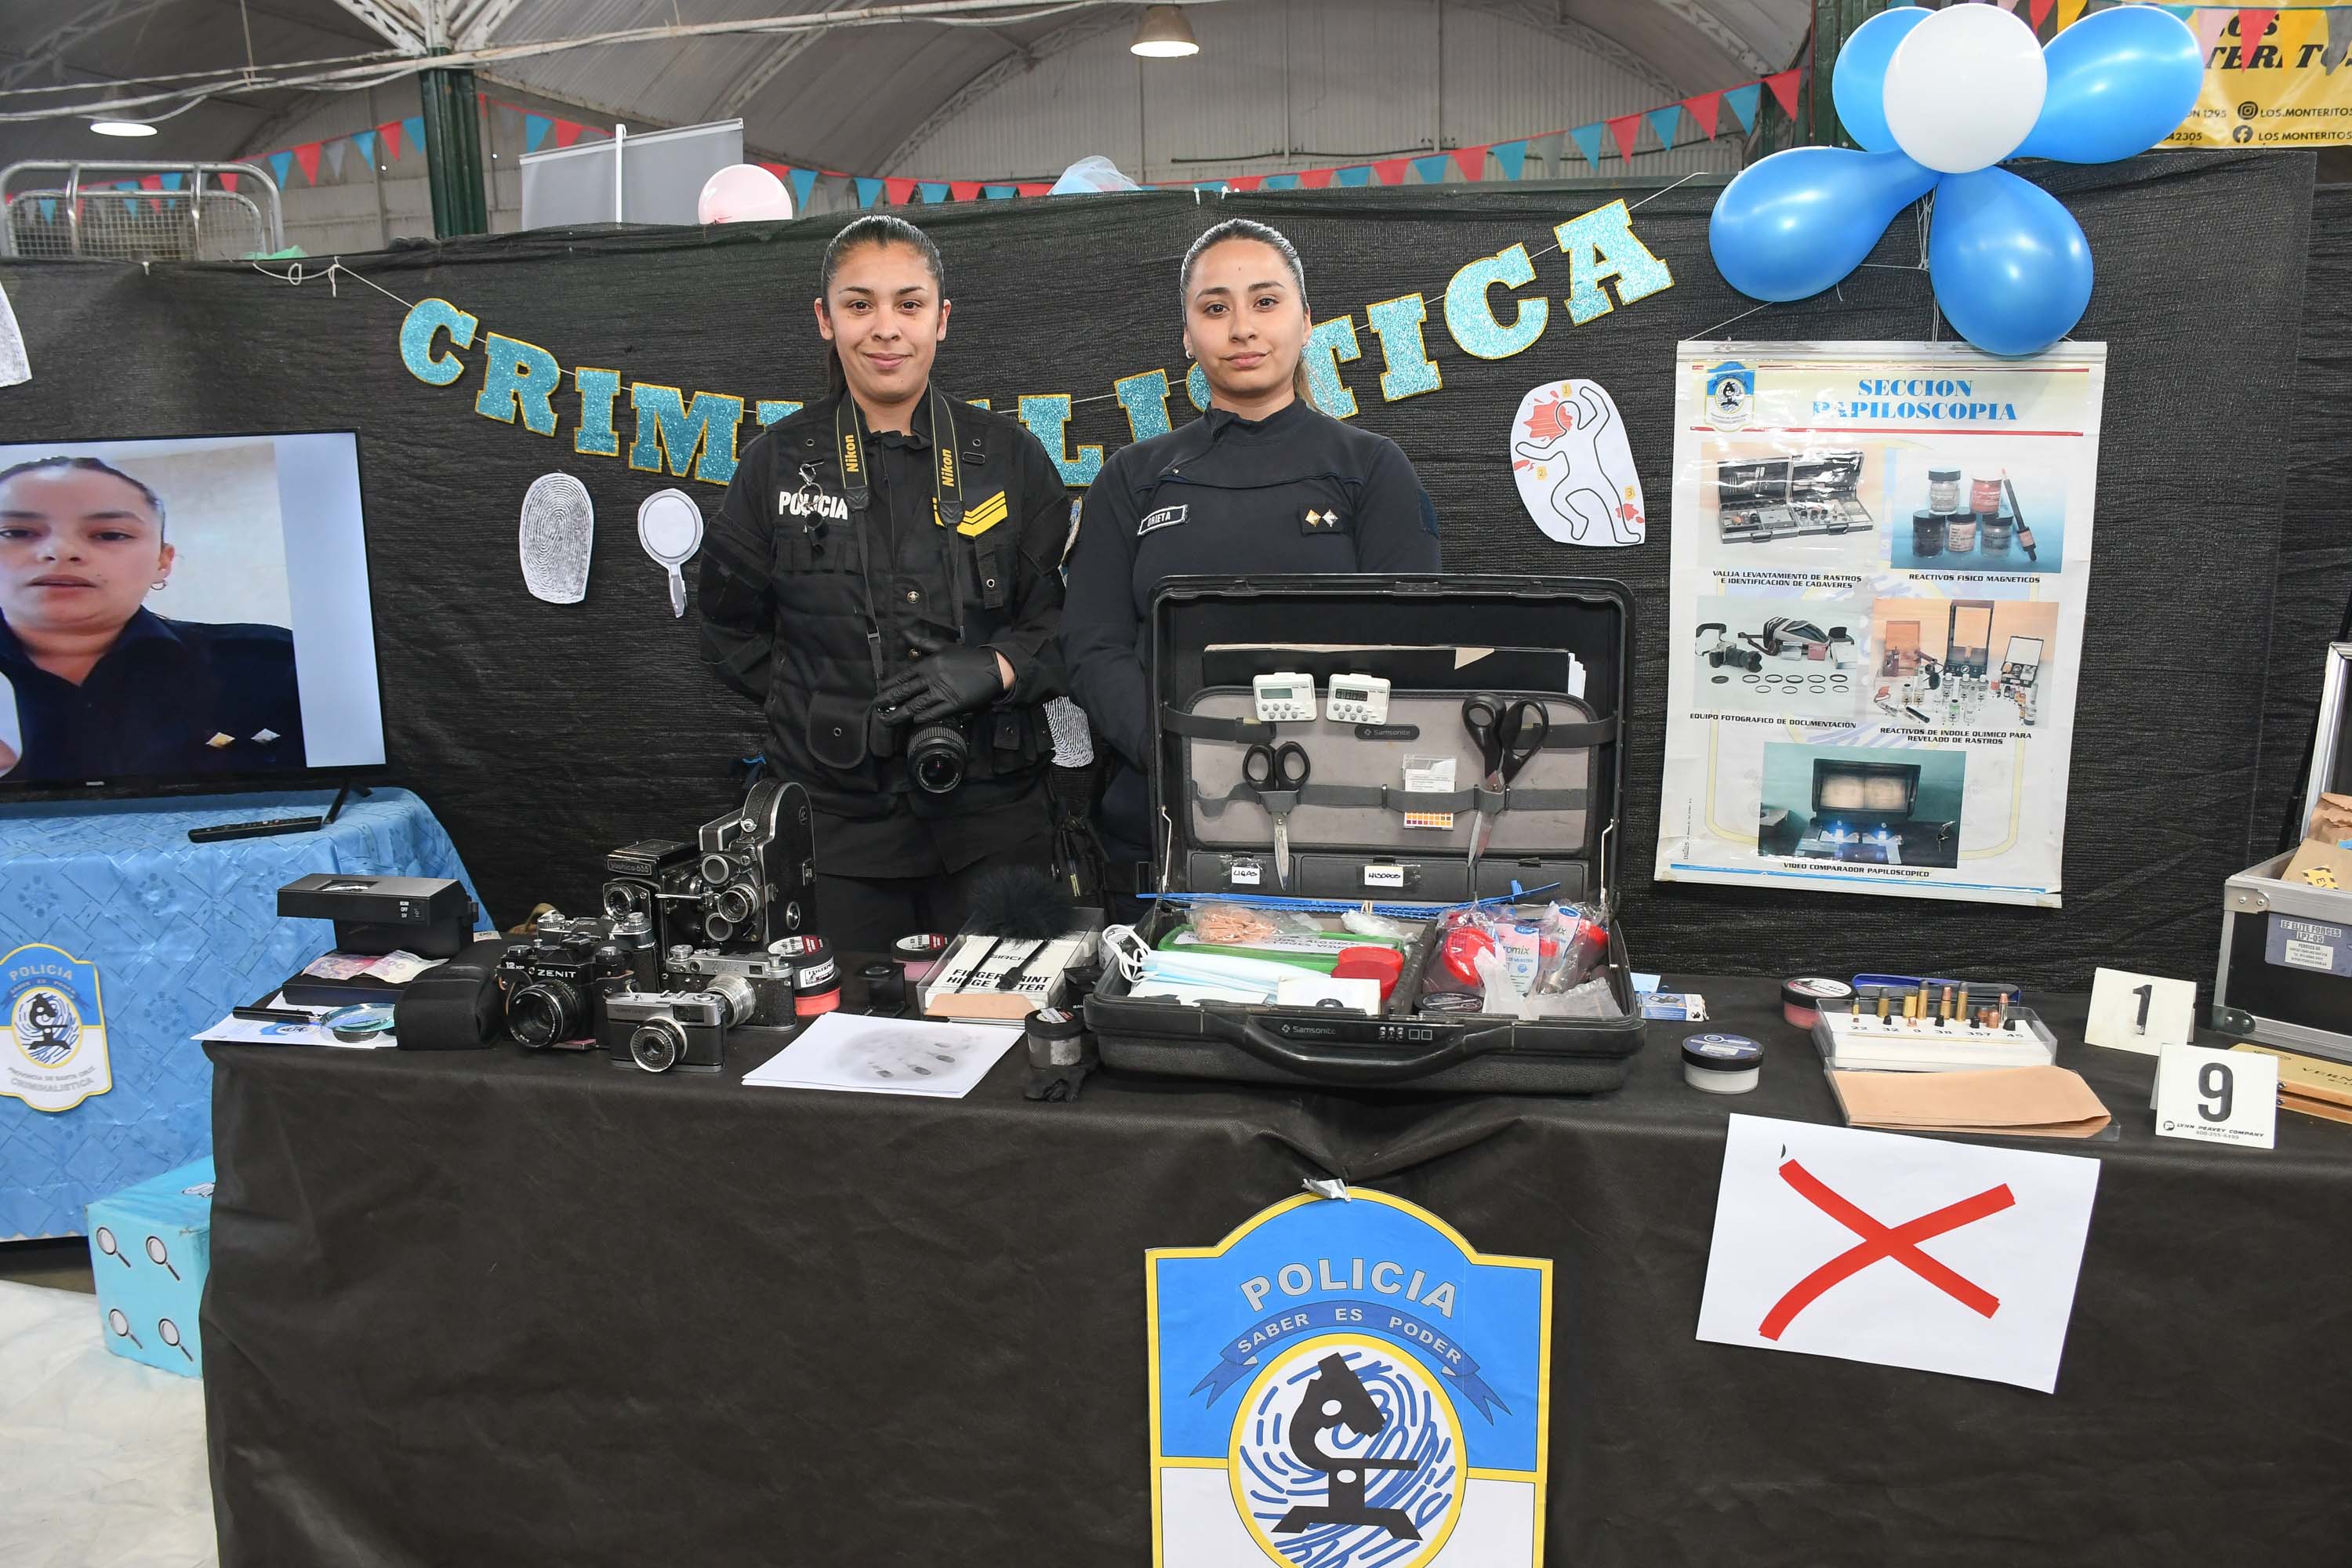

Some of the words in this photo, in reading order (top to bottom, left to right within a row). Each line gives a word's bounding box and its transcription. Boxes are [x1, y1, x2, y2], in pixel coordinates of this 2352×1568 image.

[1858, 379, 1974, 397] SECCION
[1812, 401, 2018, 420] PAPILOSCOPIA
[844, 434, 860, 473] Nikon
[941, 448, 955, 488] Nikon
[778, 491, 848, 520] POLICIA
[1742, 572, 1808, 580] LEVANTAMIENTO
[1721, 714, 1774, 724] FOTOGRAFICO
[1789, 719, 1857, 728] DOCUMENTACION
[1809, 864, 1864, 873] COMPARADOR
[1867, 868, 1929, 877] PAPILOSCOPICO
[2281, 920, 2290, 929] EF
[2292, 922, 2310, 932] ELITE
[2310, 925, 2341, 937] FORCES
[9, 964, 73, 981] POLICIA
[537, 969, 576, 978] ZENIT
[2132, 984, 2153, 1036] 1
[2198, 1062, 2234, 1123] 9
[2229, 1129, 2265, 1138] COMPANY
[1239, 1258, 1457, 1319] POLICIA
[1236, 1312, 1310, 1354] SABER
[1334, 1308, 1363, 1322] ES
[1388, 1316, 1462, 1364] PODER
